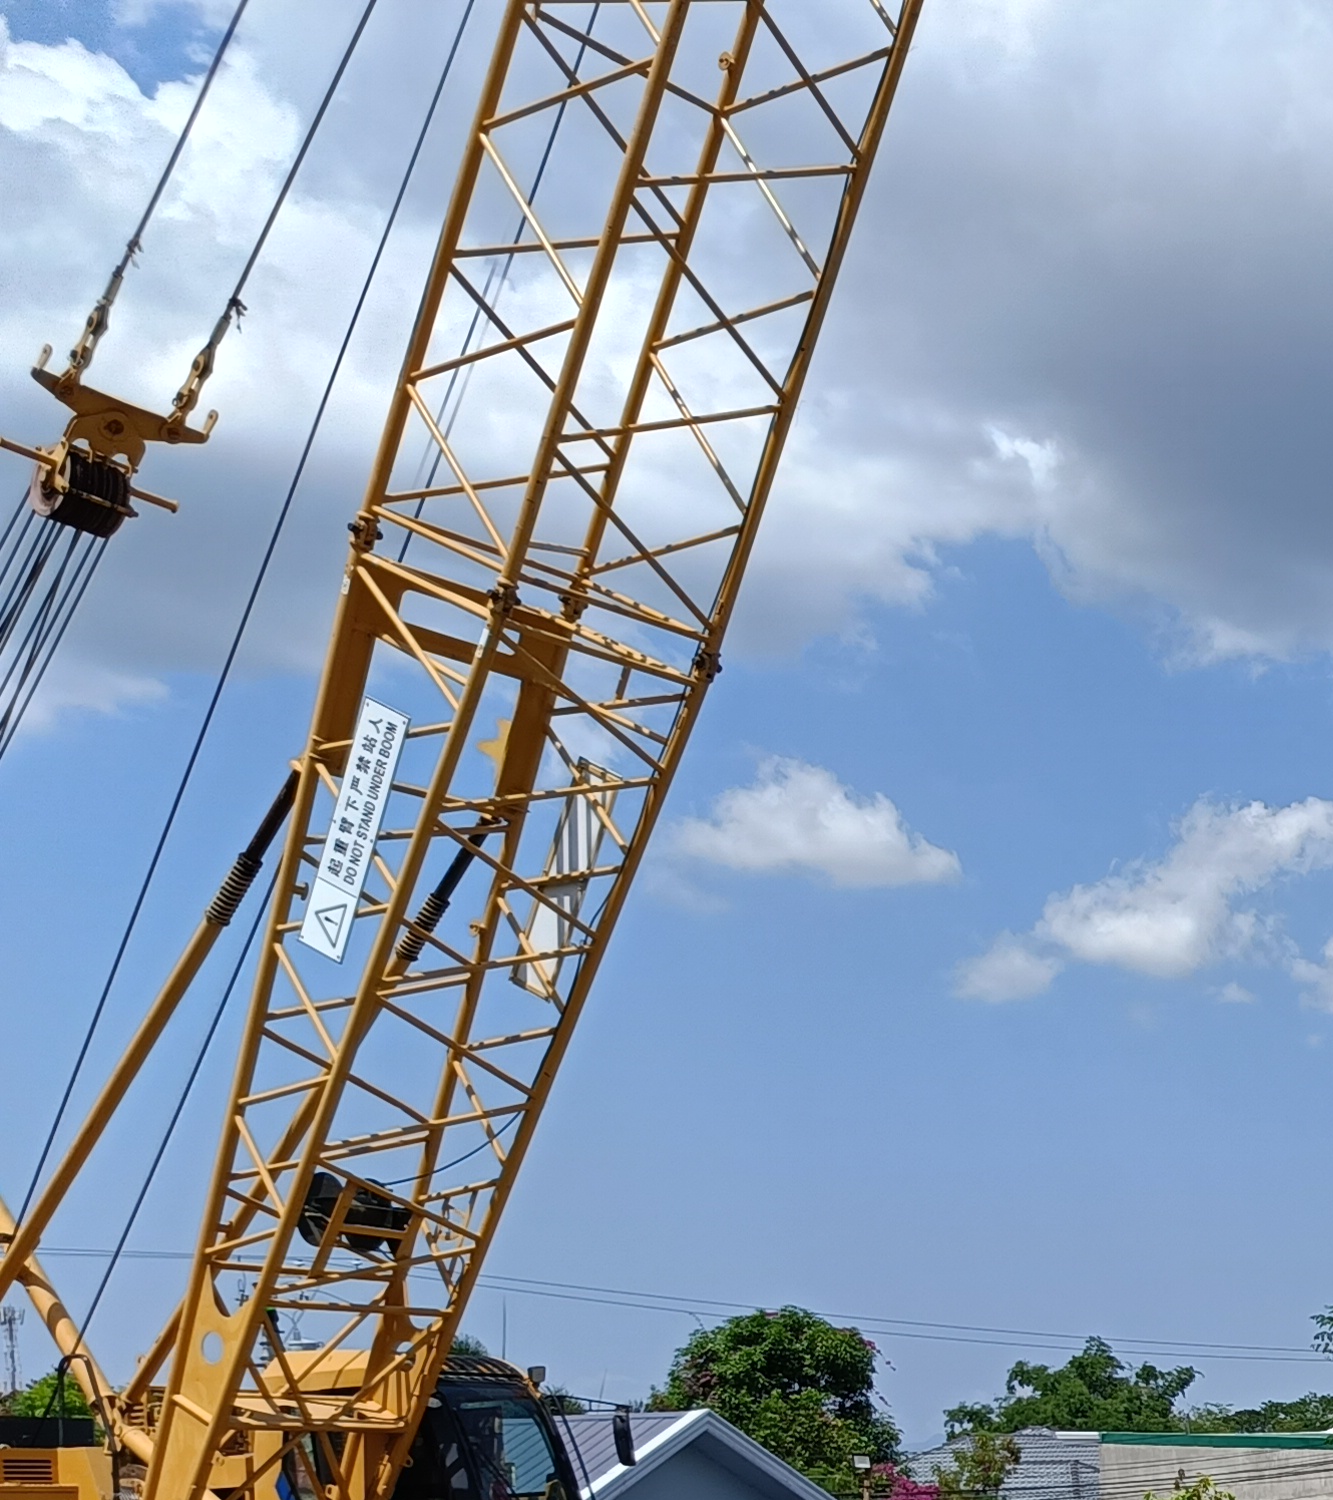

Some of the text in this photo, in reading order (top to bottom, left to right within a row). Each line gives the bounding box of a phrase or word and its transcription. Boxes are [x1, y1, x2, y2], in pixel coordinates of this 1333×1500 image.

[327, 718, 383, 878] 起重臂下严禁站人
[343, 721, 398, 886] DO NOT STAND UNDER BOOM
